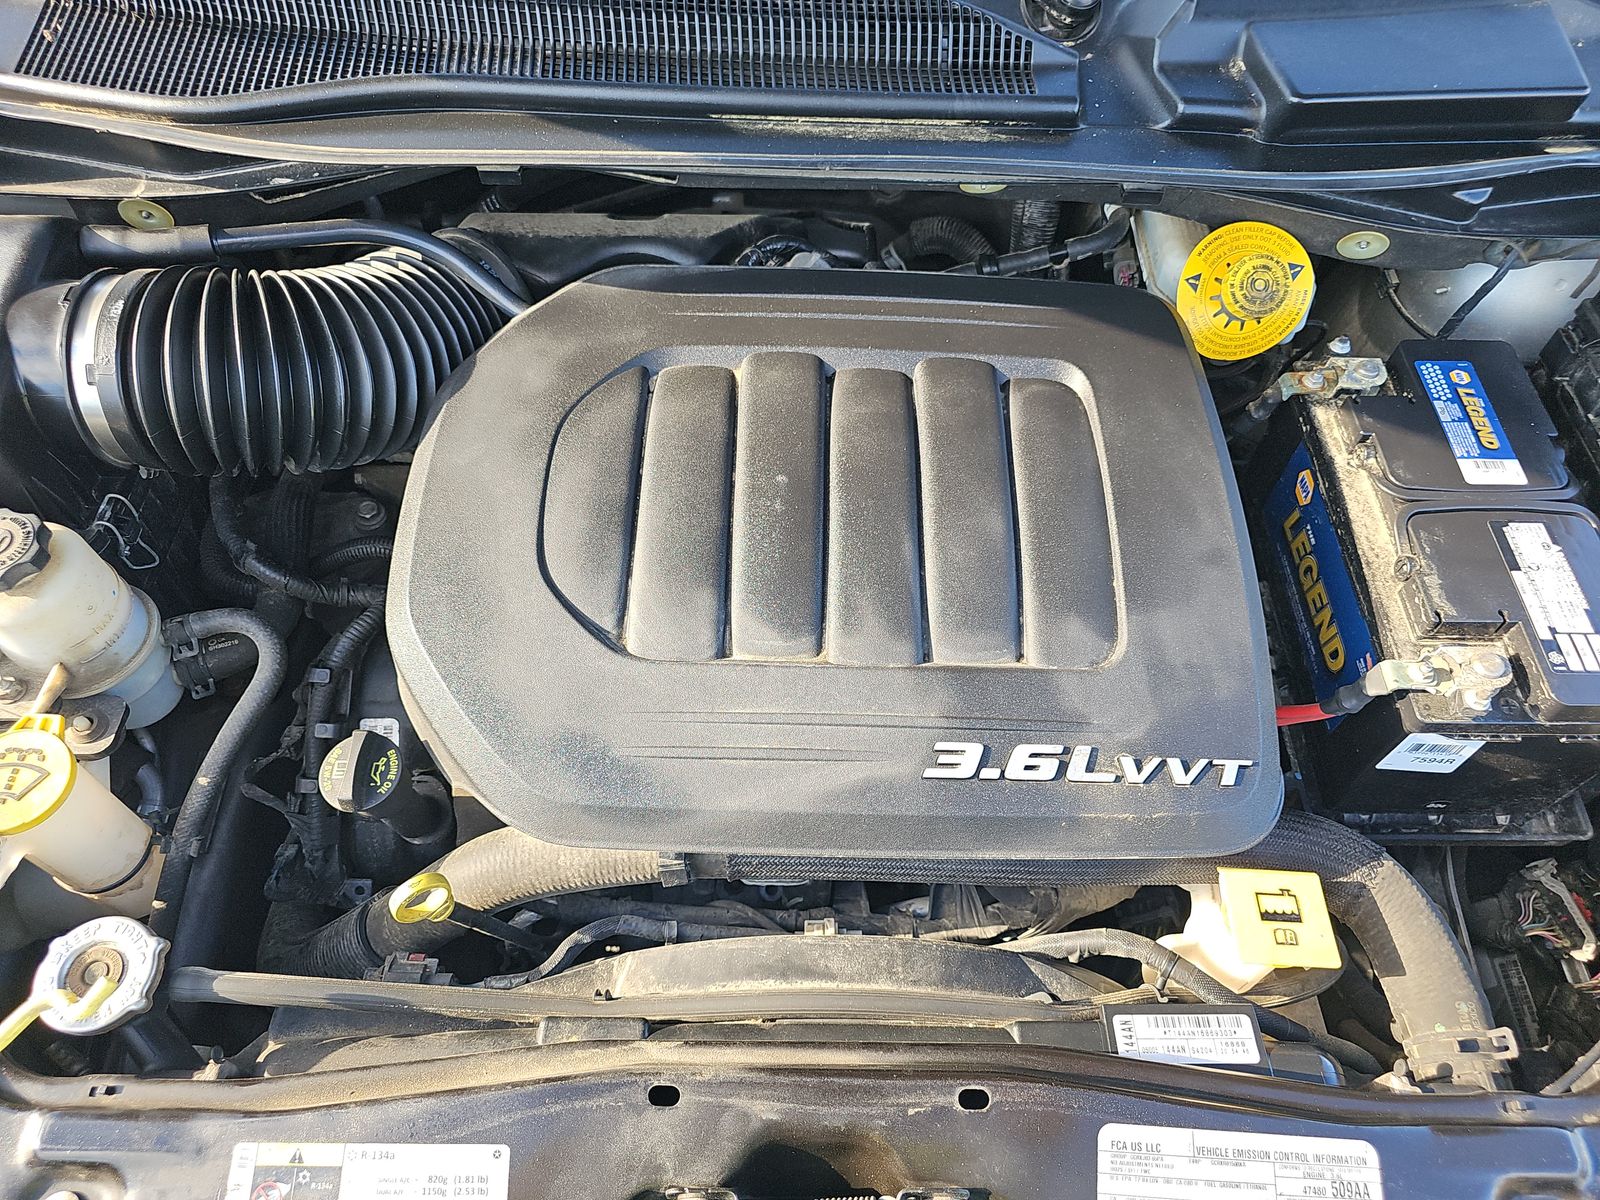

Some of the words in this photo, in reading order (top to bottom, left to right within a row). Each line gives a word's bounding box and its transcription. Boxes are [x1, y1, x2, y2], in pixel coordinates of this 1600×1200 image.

[1225, 227, 1244, 235] CLEAN
[1277, 234, 1296, 249] BEFORE
[1280, 318, 1296, 336] GARDE
[1456, 387, 1500, 450] LEGEND
[1299, 474, 1311, 502] NAPA
[1305, 524, 1316, 546] THE
[1283, 505, 1345, 673] LEGEND
[386, 749, 398, 780] ENGINE
[1410, 756, 1456, 764] 7594R
[377, 782, 392, 794] OIL
[1110, 1140, 1128, 1151] FCA
[1130, 1141, 1143, 1152] US
[1146, 1142, 1162, 1154] LLC
[1196, 1146, 1229, 1158] VEHICLE
[1232, 1148, 1271, 1160] EMISSION
[1273, 1150, 1310, 1163] CONTROL
[1312, 1153, 1368, 1166] INFORMATION
[428, 1175, 448, 1186] 820g
[454, 1175, 476, 1186] (1.81
[477, 1175, 489, 1186] lb)
[1330, 1181, 1371, 1199] 509AA
[422, 1186, 447, 1197] 1150g
[454, 1186, 476, 1197] (2.53
[477, 1186, 489, 1197] lb)
